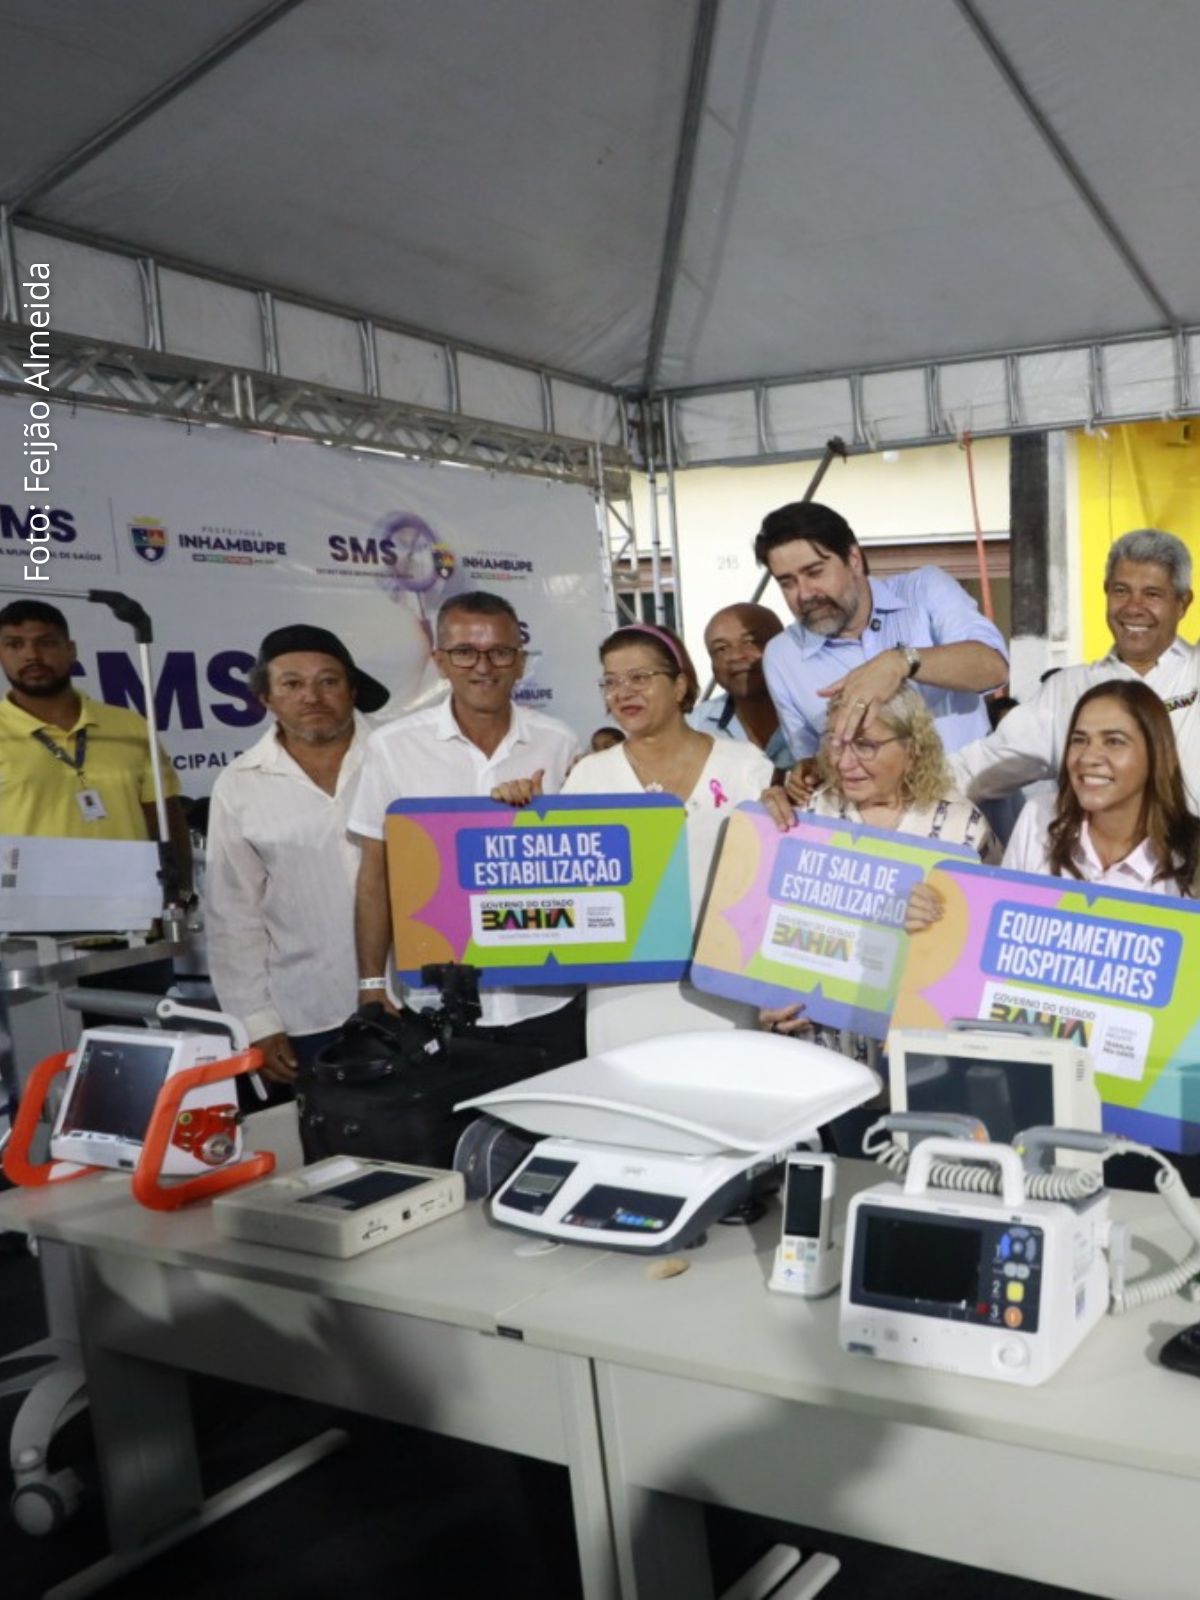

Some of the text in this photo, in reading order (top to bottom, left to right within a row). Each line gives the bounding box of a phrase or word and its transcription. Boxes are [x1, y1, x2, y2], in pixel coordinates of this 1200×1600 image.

[0, 504, 77, 543] MS
[178, 533, 288, 556] INHAMBUPE
[328, 534, 398, 567] SMS
[72, 650, 268, 731] MS
[173, 751, 228, 770] CIPAL
[485, 832, 603, 859] KIT SALA DE
[474, 853, 623, 887] ESTABILIZAÇÃO
[797, 849, 900, 894] KIT SALA DE
[481, 908, 576, 931] BAHIA
[541, 898, 574, 908] ESTADO
[771, 921, 855, 962] BAHIA
[998, 909, 1165, 968] EQUIPAMENTOS
[995, 943, 1158, 1001] HOSPITALARES
[993, 992, 1097, 1020] GOVERNO DO ESTADO
